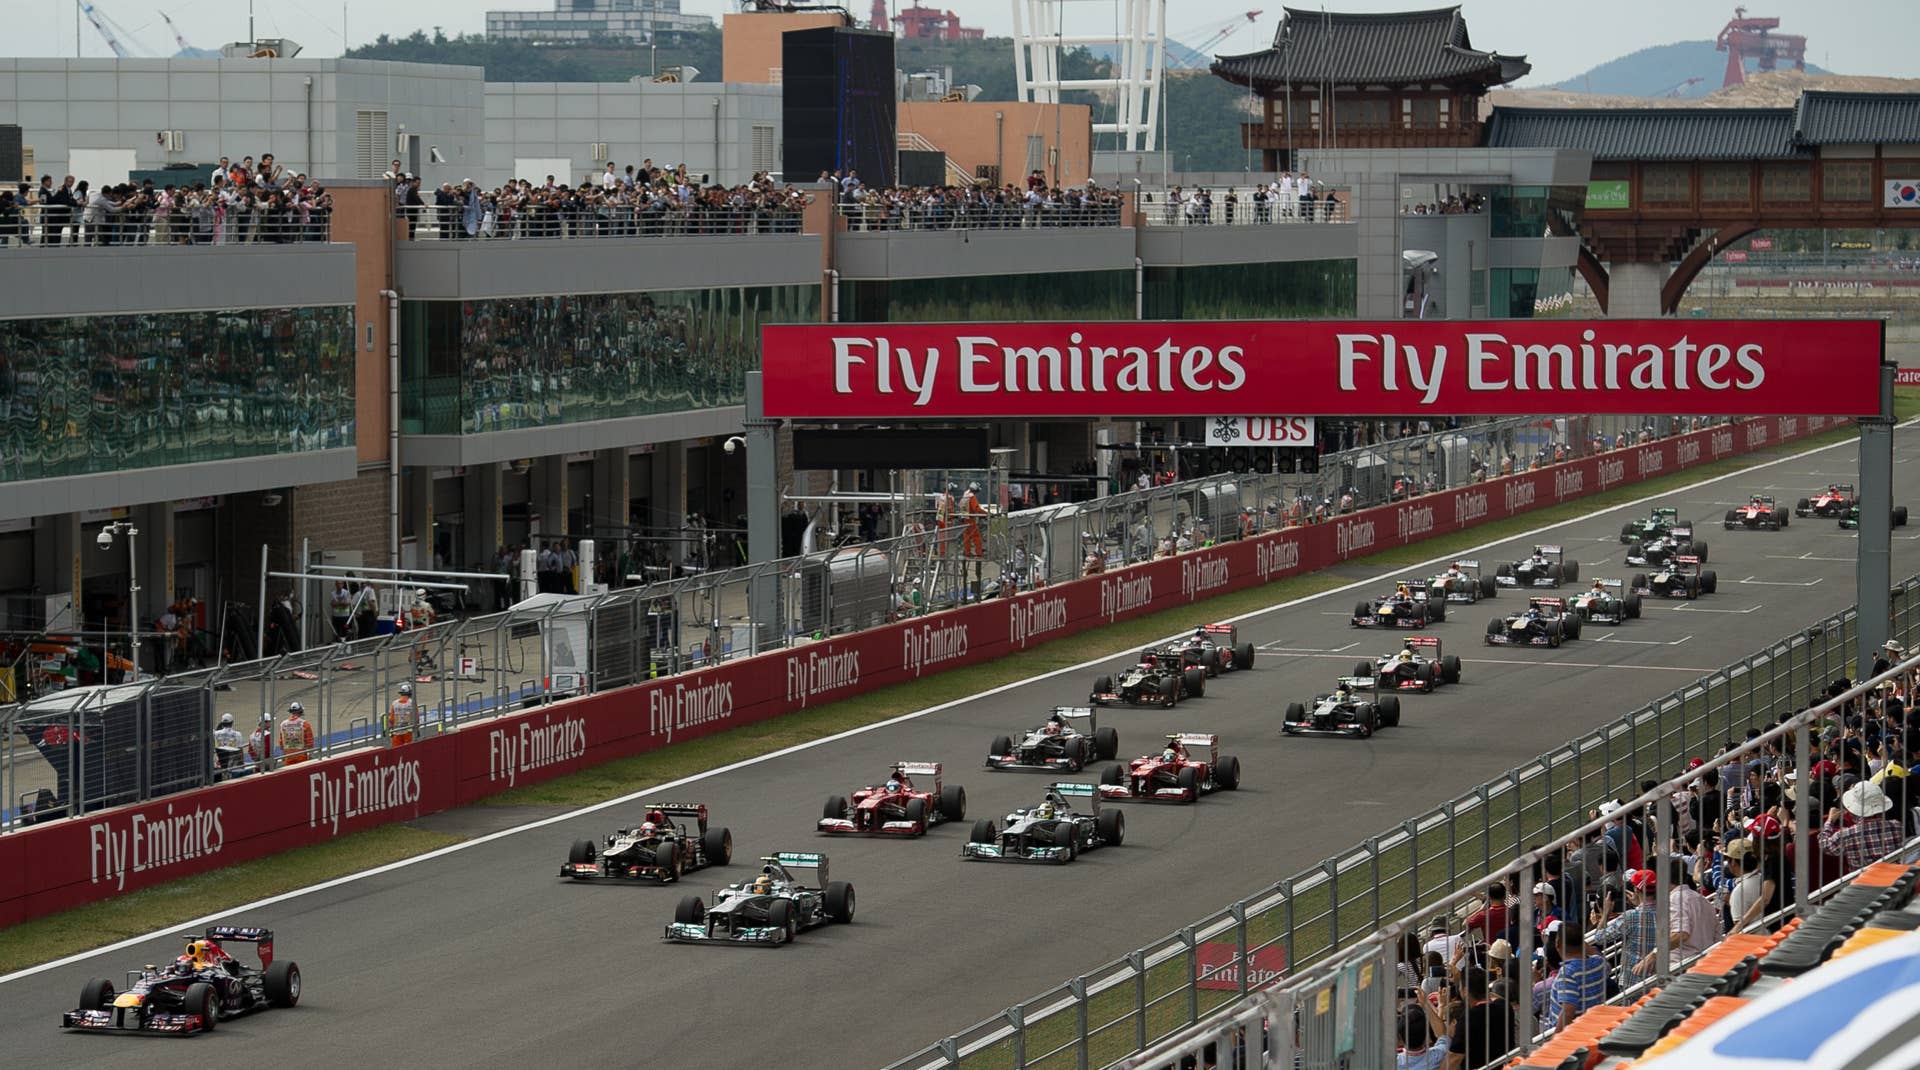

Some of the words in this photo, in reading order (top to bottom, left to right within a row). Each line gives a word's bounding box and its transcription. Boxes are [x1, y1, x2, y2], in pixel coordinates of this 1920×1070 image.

[831, 337, 939, 406] Fly
[956, 332, 1246, 393] Emirates
[1336, 333, 1447, 404] Fly
[1464, 329, 1765, 391] Emirates
[1894, 371, 1920, 383] rate
[1245, 416, 1307, 442] UBS
[1182, 559, 1196, 601] Fly
[1196, 553, 1229, 592] Emirates
[1257, 543, 1269, 582] Fly
[1010, 602, 1026, 648] Fly
[1028, 592, 1067, 637] Emirates
[1101, 579, 1116, 623] Fly
[1117, 571, 1153, 613] Emirates
[462, 658, 473, 675] F
[903, 627, 922, 677] Fly
[923, 619, 968, 665] Emirates
[787, 656, 807, 708] Fly
[809, 645, 860, 695] Emirates
[650, 688, 673, 743] Fly
[676, 676, 733, 730] Emirates
[490, 729, 517, 788] Fly
[520, 713, 585, 773] Emirates
[309, 771, 340, 836] Fly
[344, 755, 420, 819] Emirates
[90, 822, 127, 891] Fly
[132, 803, 223, 873] Emirates
[778, 852, 819, 860] PETRNA
[214, 926, 265, 934] INFNIT
[1201, 963, 1285, 984] Emiate
[1232, 951, 1255, 966] Fy
